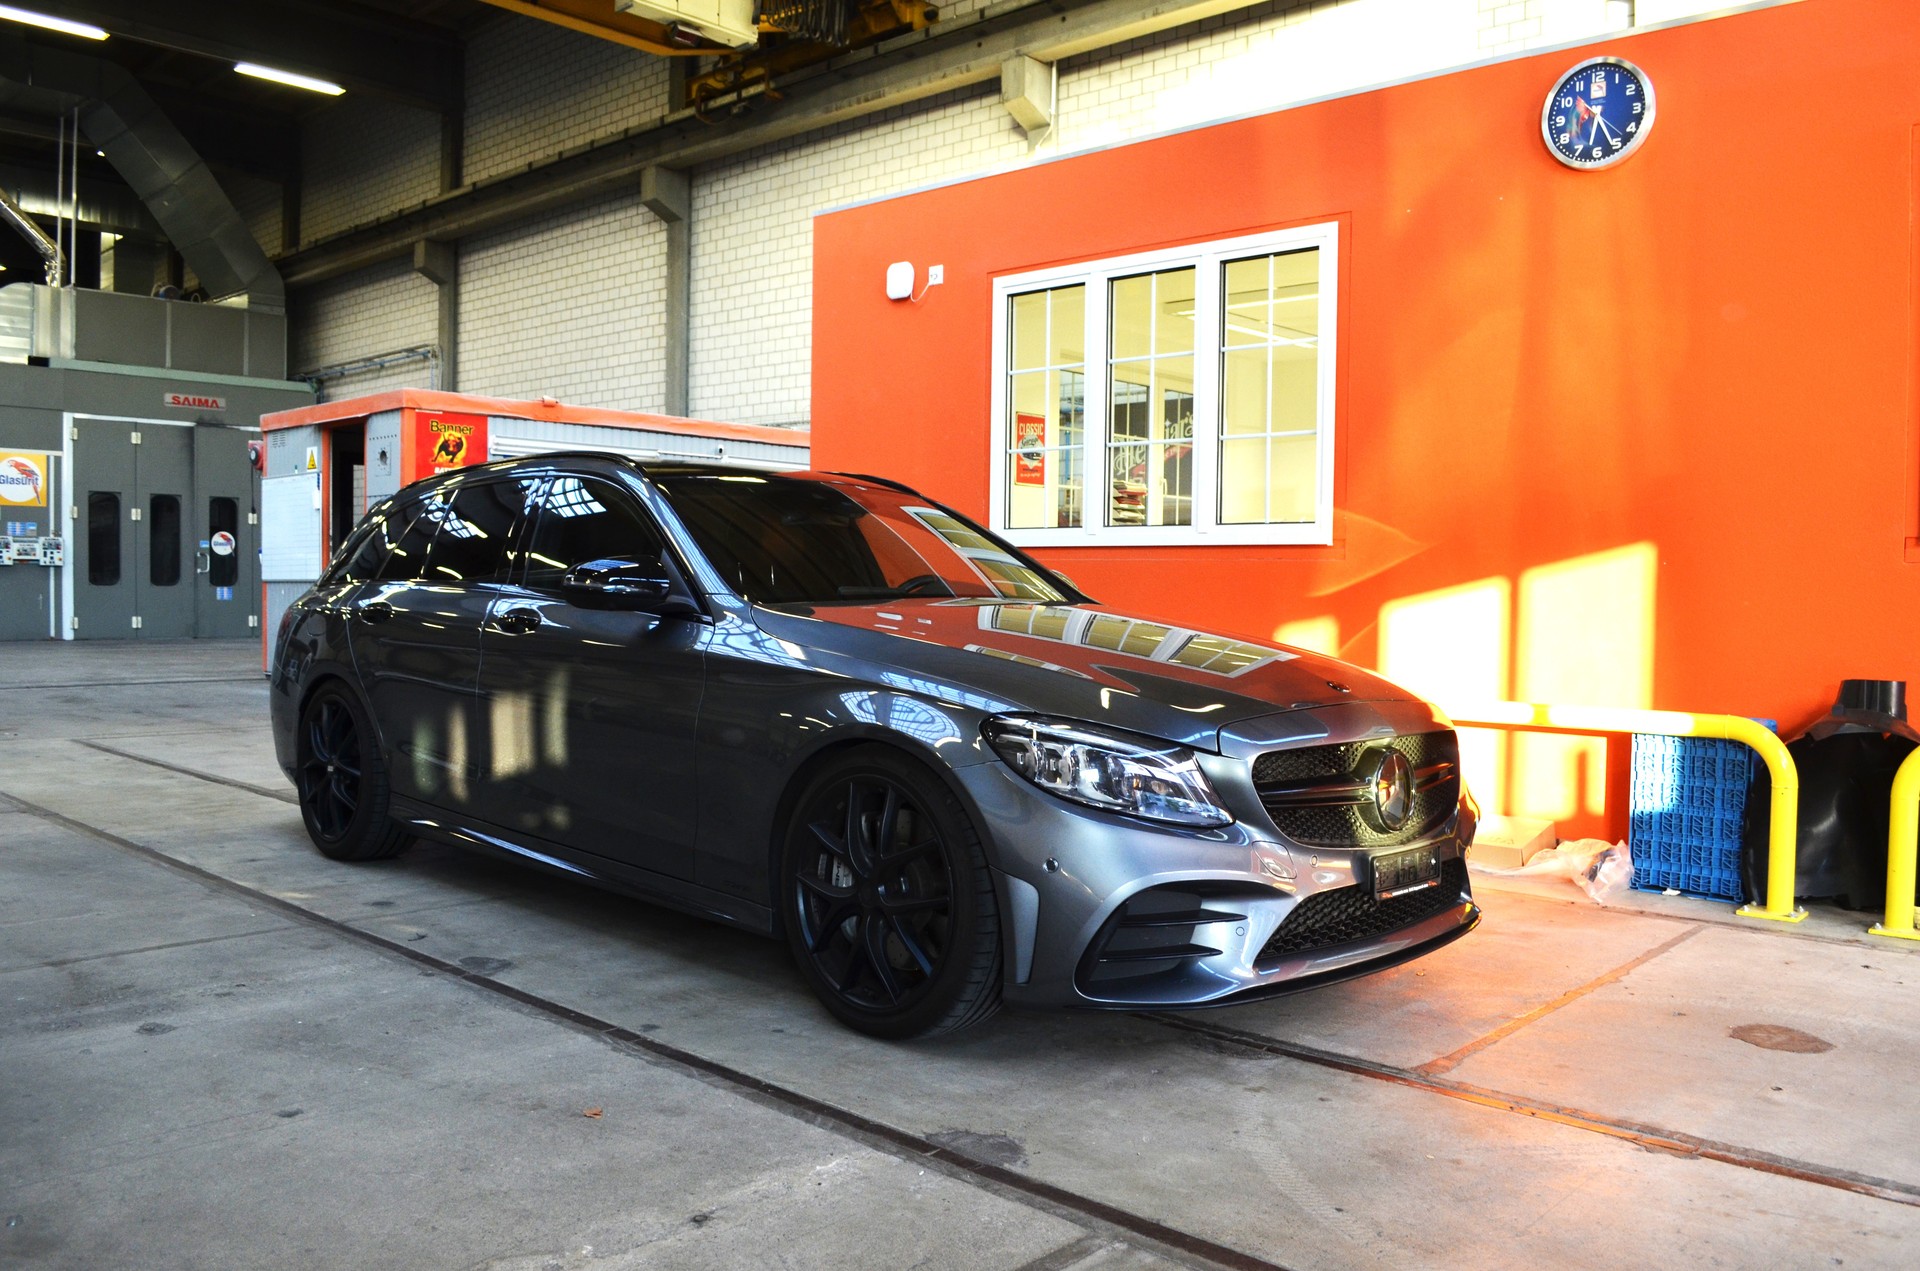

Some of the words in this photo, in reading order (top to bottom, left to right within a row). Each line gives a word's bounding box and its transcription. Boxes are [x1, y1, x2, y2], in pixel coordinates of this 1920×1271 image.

[1592, 71, 1605, 83] 12
[1576, 80, 1584, 92] 11
[1626, 84, 1636, 96] 2
[1561, 97, 1573, 108] 10
[1632, 102, 1642, 114] 3
[1555, 115, 1565, 127] 9
[1626, 122, 1636, 133] 4
[1560, 133, 1570, 144] 8
[1611, 138, 1622, 150] 5
[1574, 145, 1584, 157] 7
[1592, 147, 1602, 158] 6
[171, 395, 220, 409] SAIMA
[430, 420, 474, 435] Banner
[1019, 423, 1044, 436] CLASSIC
